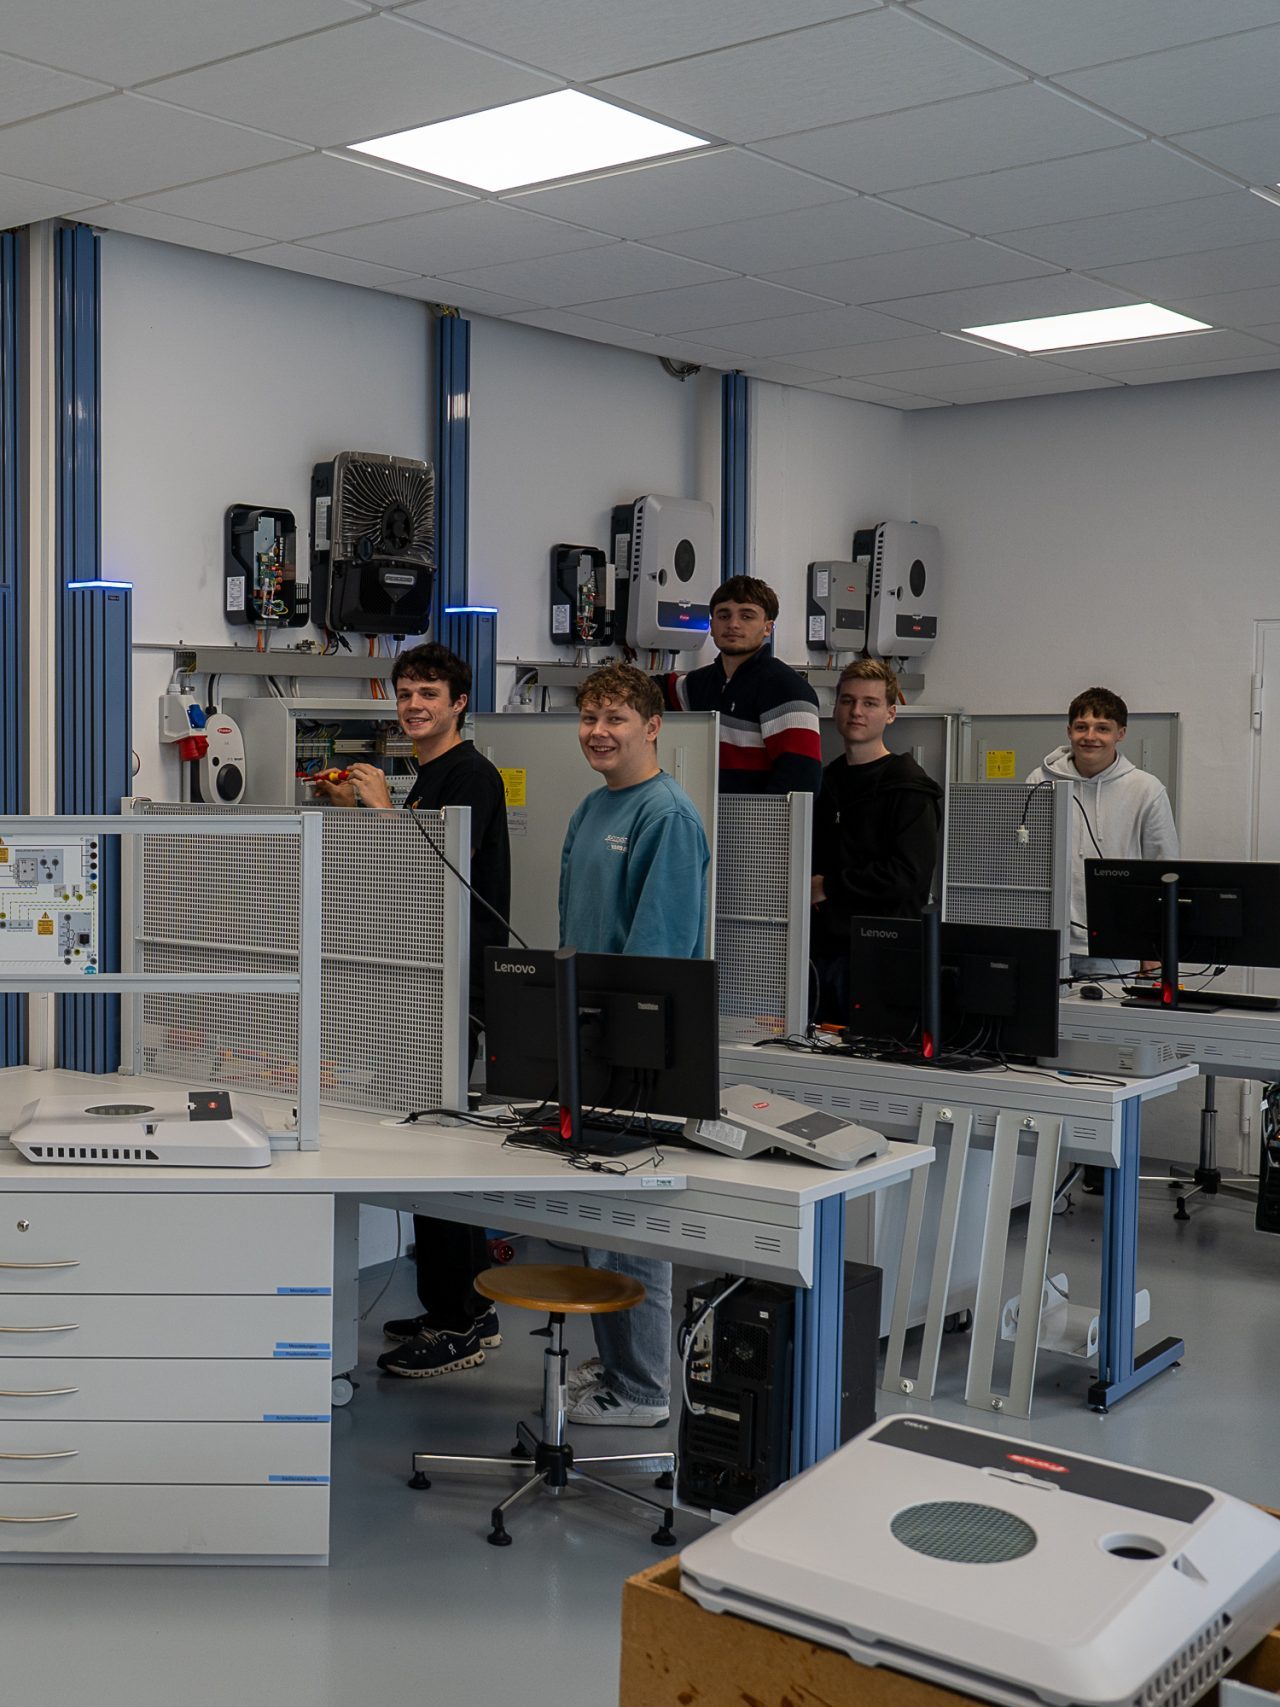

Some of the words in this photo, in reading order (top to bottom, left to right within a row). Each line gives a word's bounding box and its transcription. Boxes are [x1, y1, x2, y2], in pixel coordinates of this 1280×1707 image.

[1094, 867, 1130, 877] Lenovo
[860, 927, 899, 939] Lenovo
[494, 961, 536, 974] Lenovo
